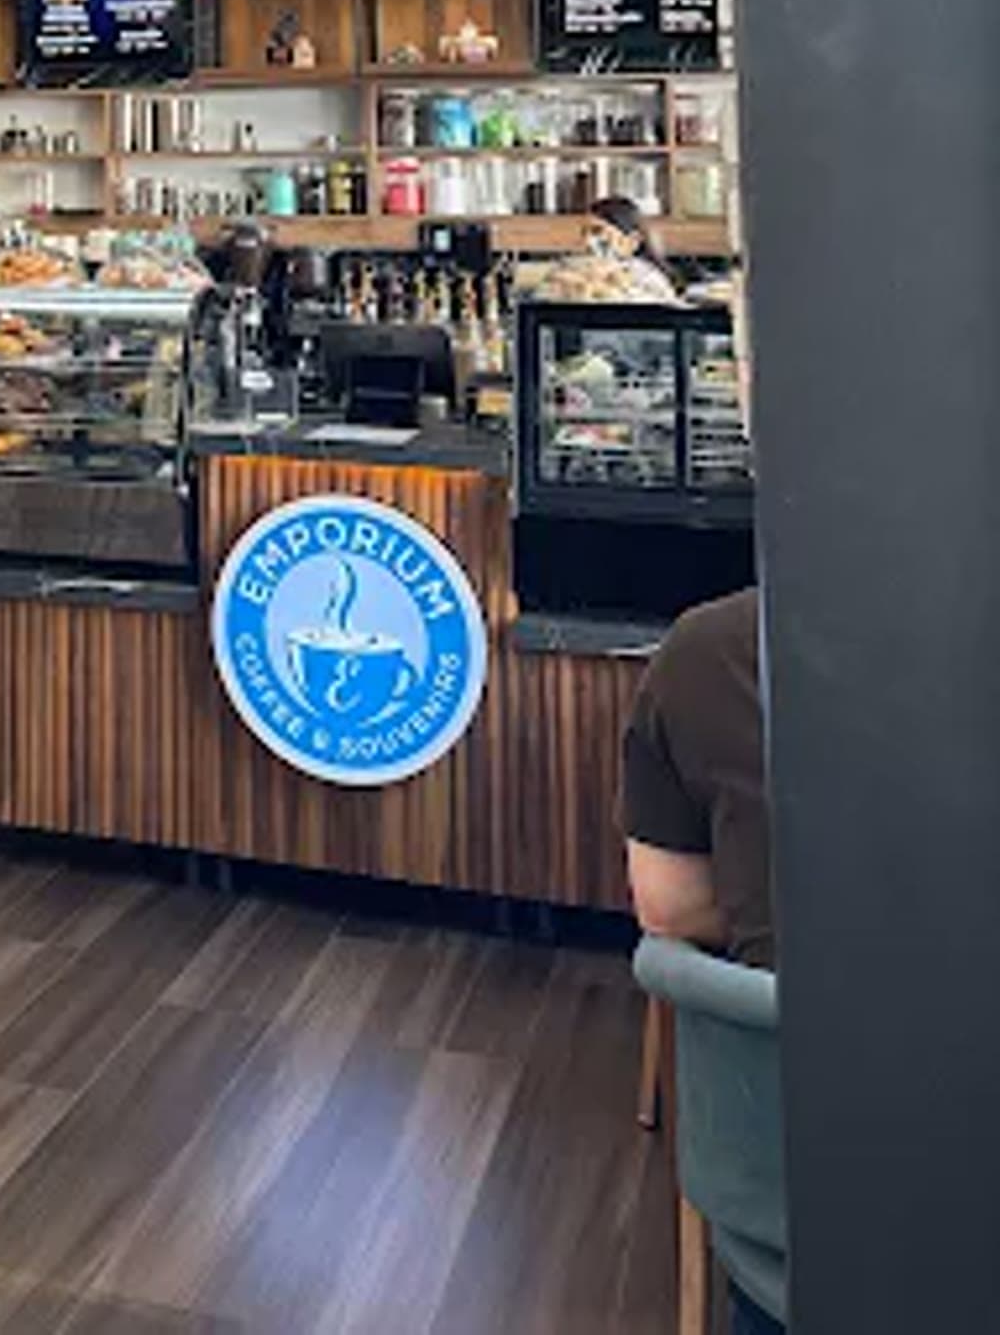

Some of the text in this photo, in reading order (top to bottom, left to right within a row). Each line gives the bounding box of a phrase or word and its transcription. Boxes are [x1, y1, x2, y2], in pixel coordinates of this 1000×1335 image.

[239, 517, 455, 620] EMPORIUM
[235, 633, 304, 739] COFFEE
[338, 653, 460, 760] SOUVENIRS
